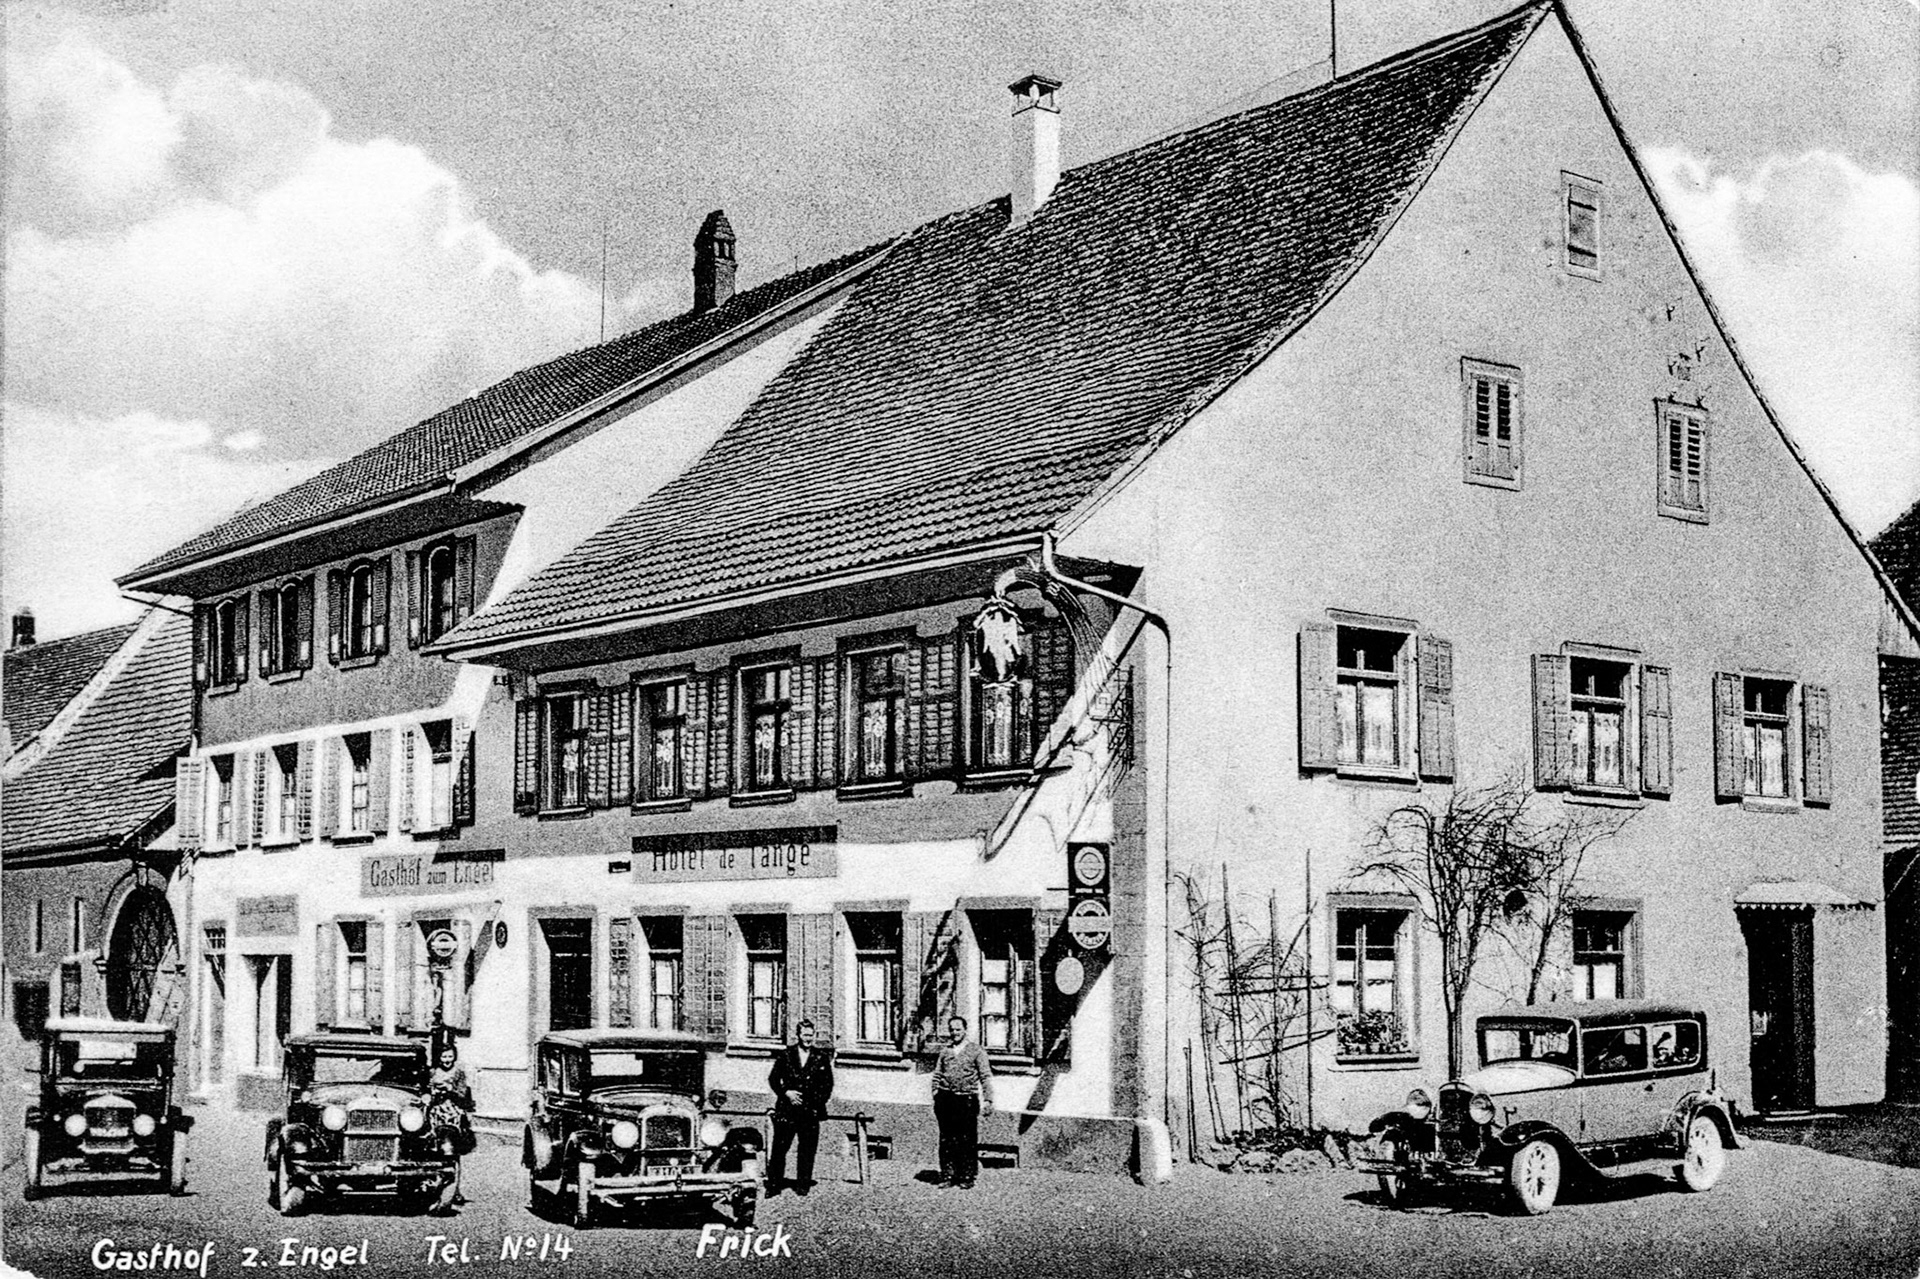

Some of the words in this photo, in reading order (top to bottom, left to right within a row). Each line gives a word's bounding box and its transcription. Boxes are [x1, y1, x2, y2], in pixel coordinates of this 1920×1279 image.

[719, 847, 735, 869] de
[370, 857, 421, 887] Gasthof
[427, 871, 446, 885] zum
[453, 859, 494, 884] Engel
